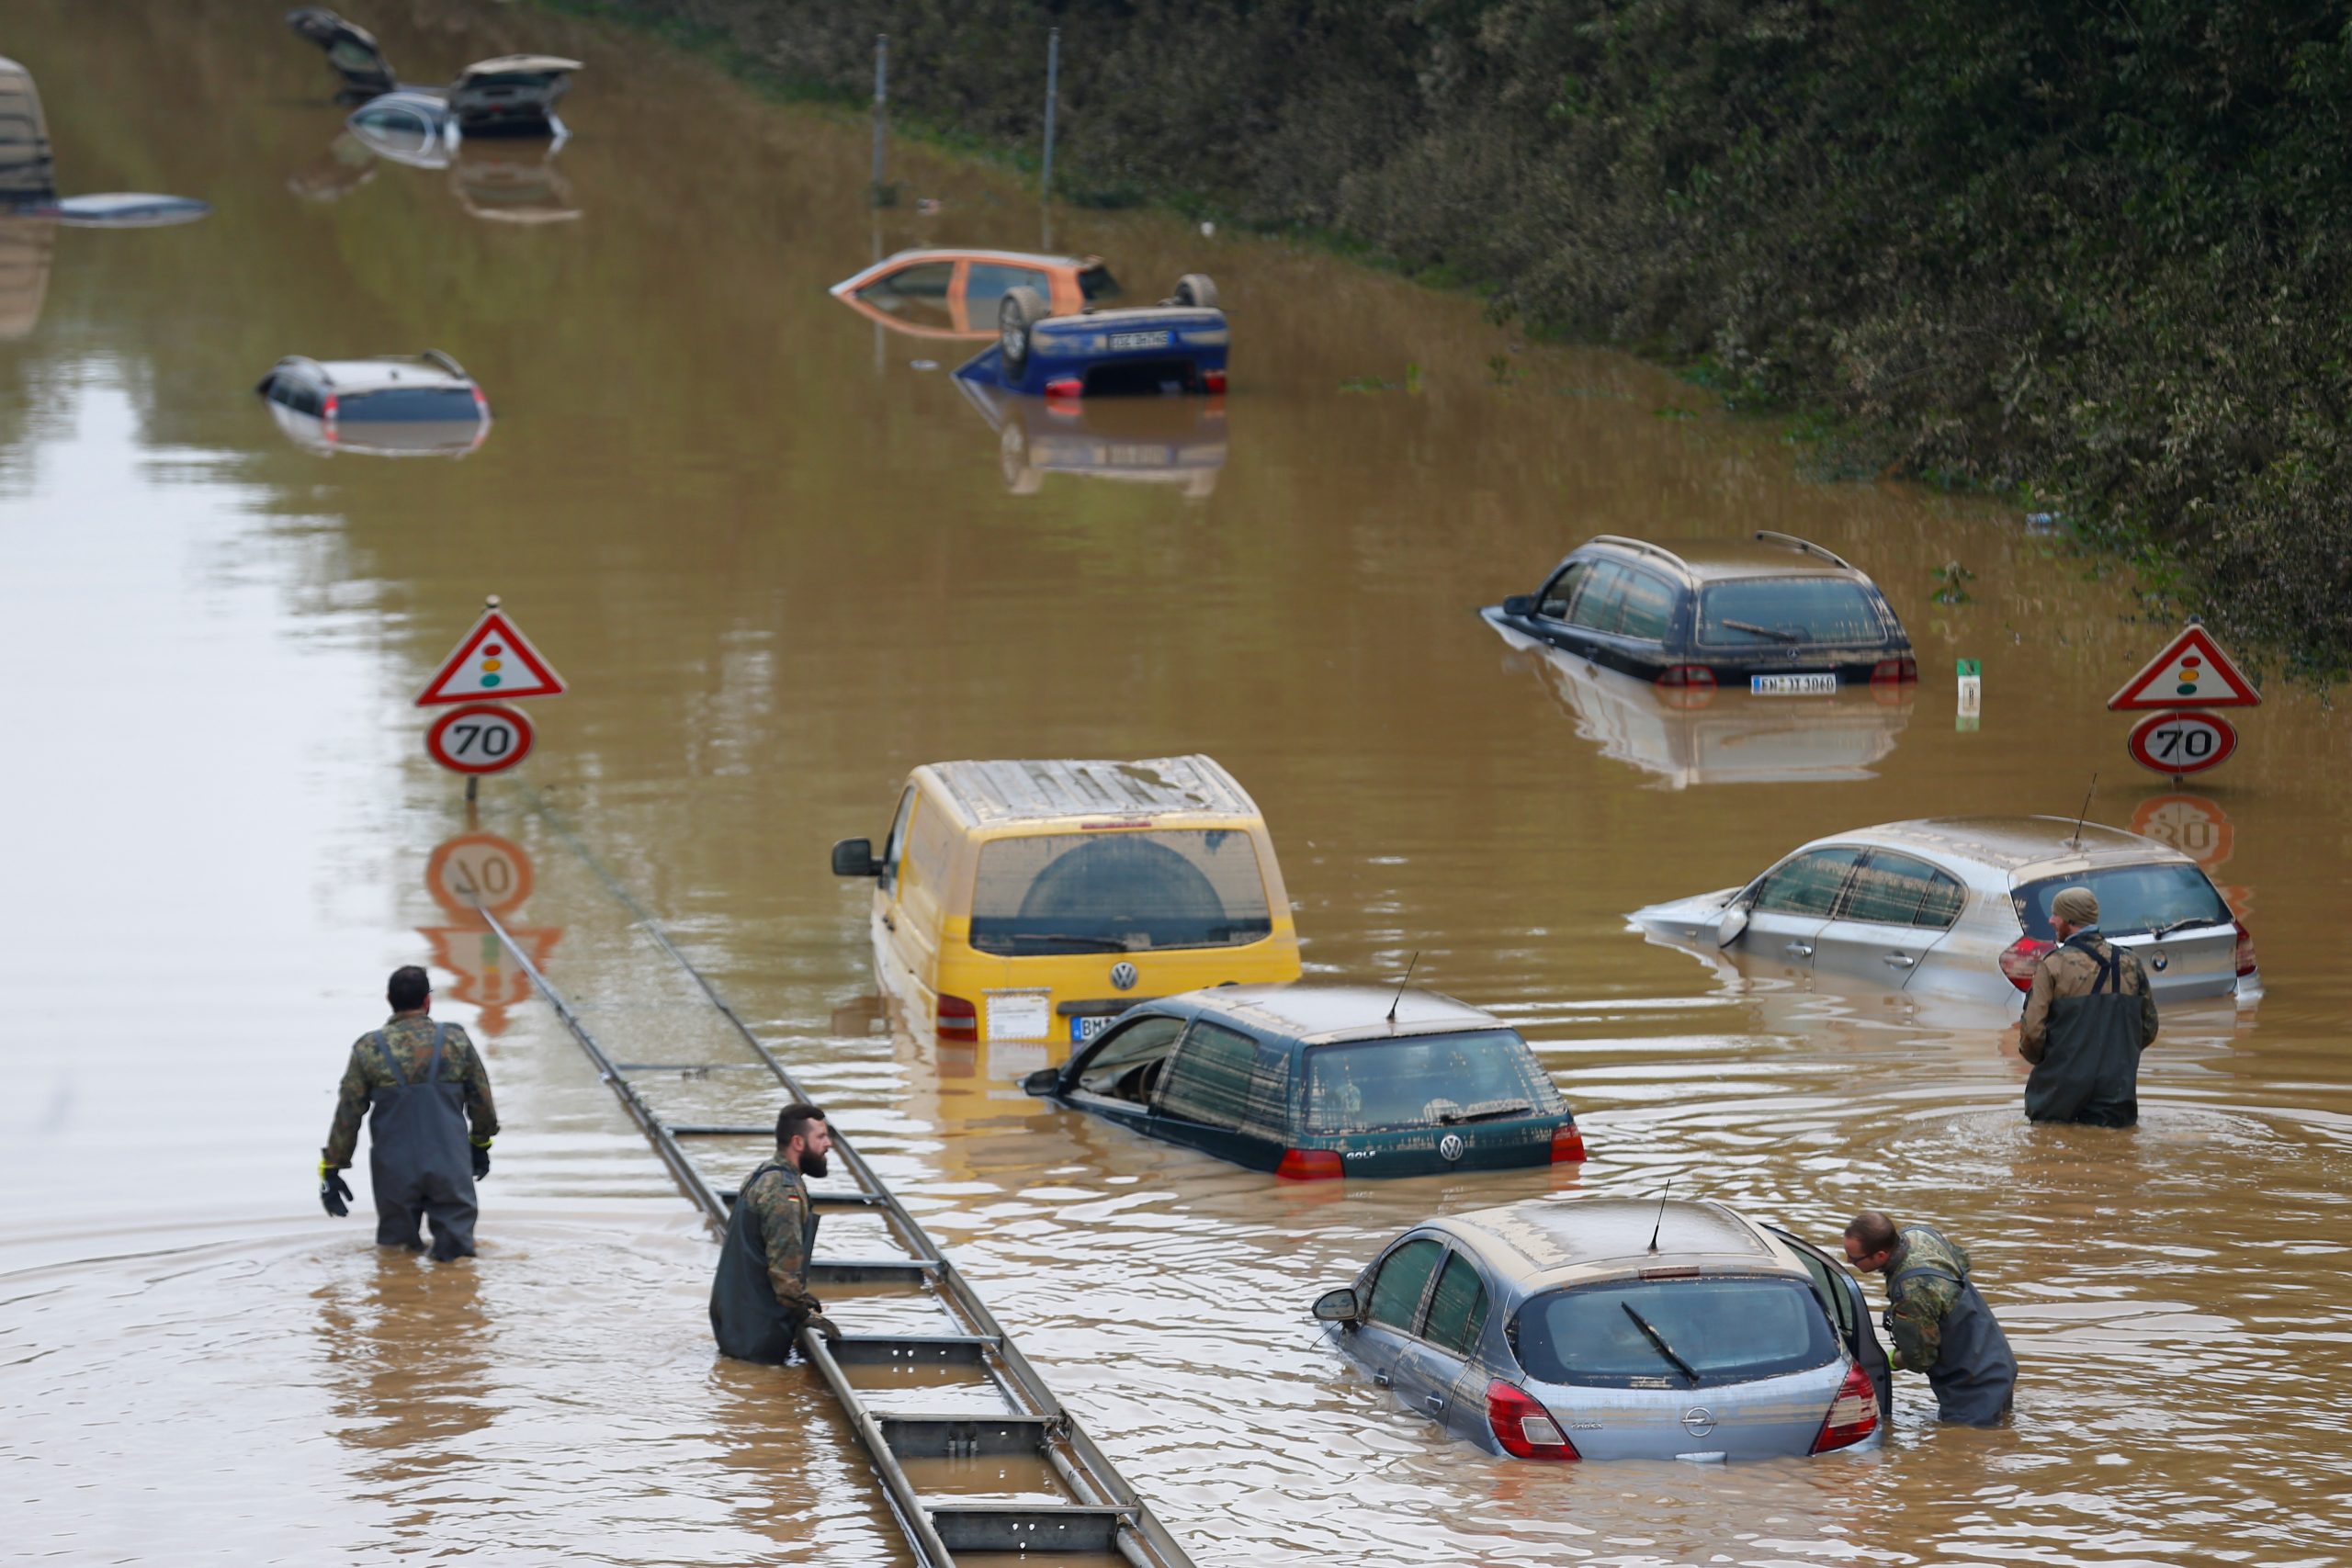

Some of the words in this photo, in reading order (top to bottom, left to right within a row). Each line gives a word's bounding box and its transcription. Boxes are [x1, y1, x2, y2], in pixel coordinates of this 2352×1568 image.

[1761, 677, 1778, 693] EN
[454, 725, 509, 756] 70
[2156, 729, 2212, 758] 70
[1346, 1150, 1376, 1160] GOLF
